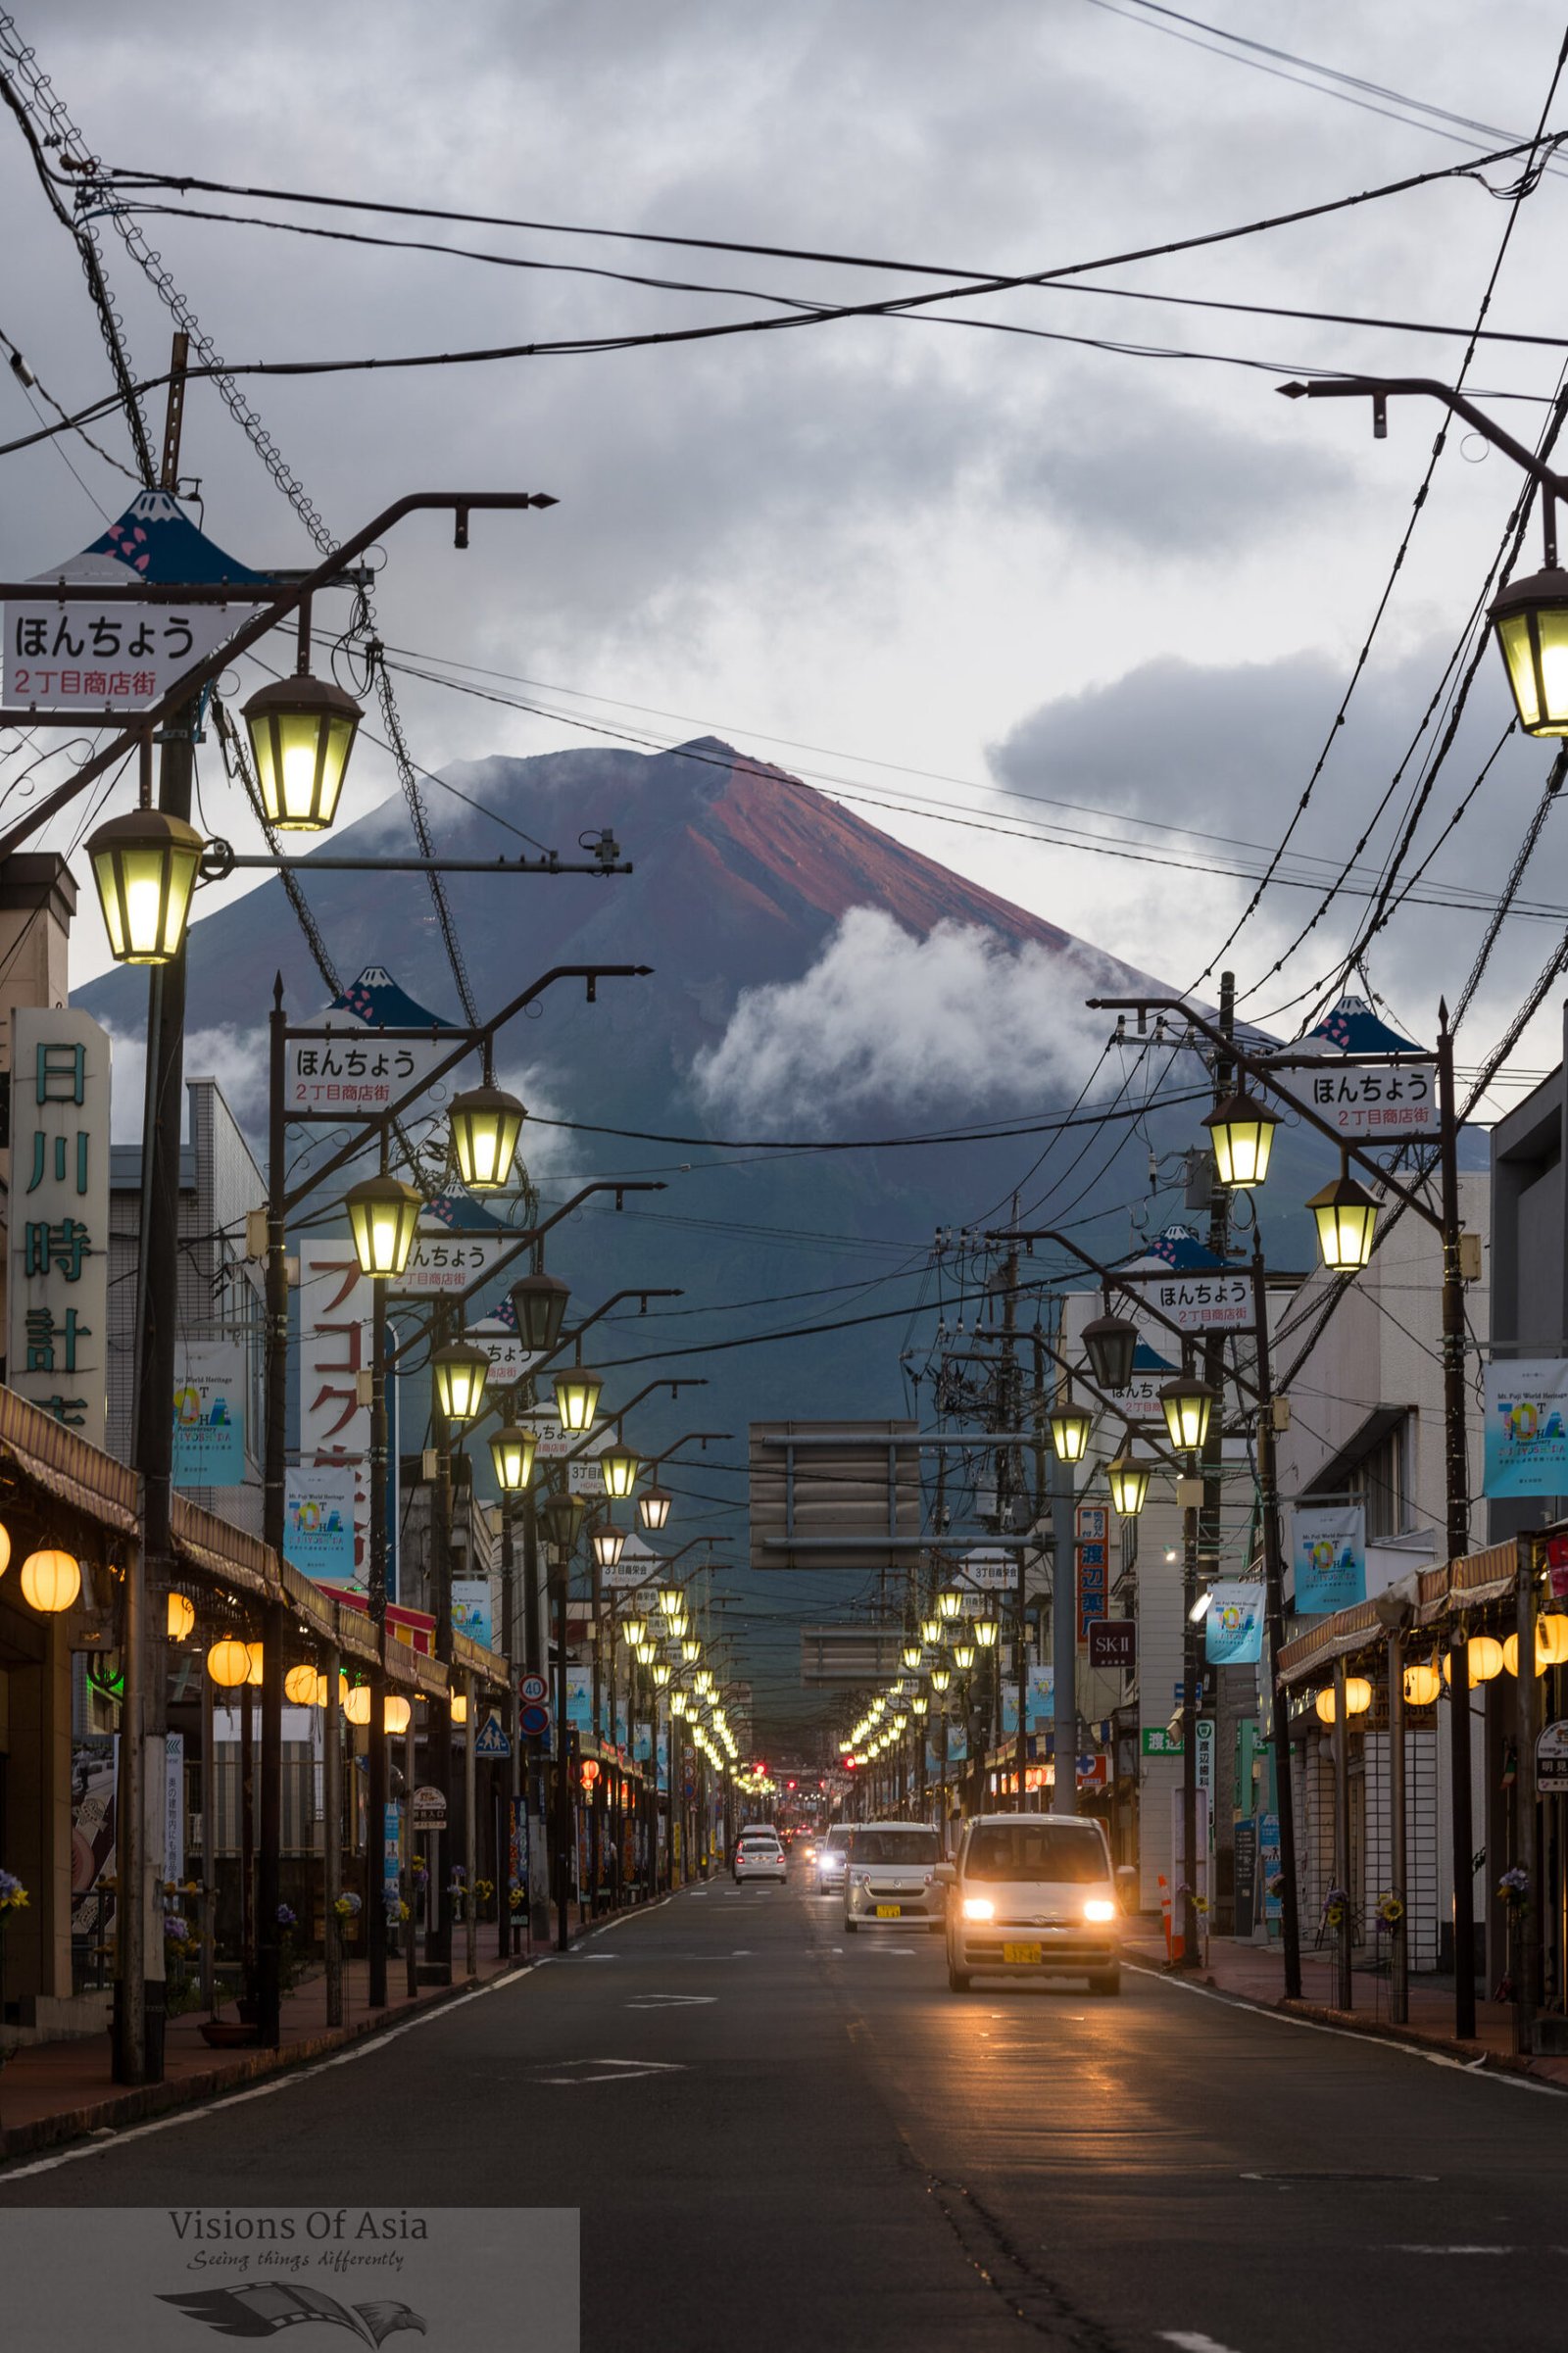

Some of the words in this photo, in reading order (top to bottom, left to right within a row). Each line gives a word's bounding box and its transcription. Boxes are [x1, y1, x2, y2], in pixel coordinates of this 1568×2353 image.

[17, 615, 193, 659] ほんちょう
[15, 669, 156, 696] 2丁目商店街
[297, 1049, 415, 1078] ほんちょう
[296, 1084, 390, 1102] 2丁目商店街
[1314, 1074, 1428, 1103] ほんちょう
[1339, 1107, 1430, 1126] 2丁目商店街
[407, 1247, 484, 1268] んちょう
[1160, 1282, 1246, 1307] ほんちょう
[1179, 1307, 1247, 1323] 2丁目商店街
[525, 1682, 542, 1696] 40
